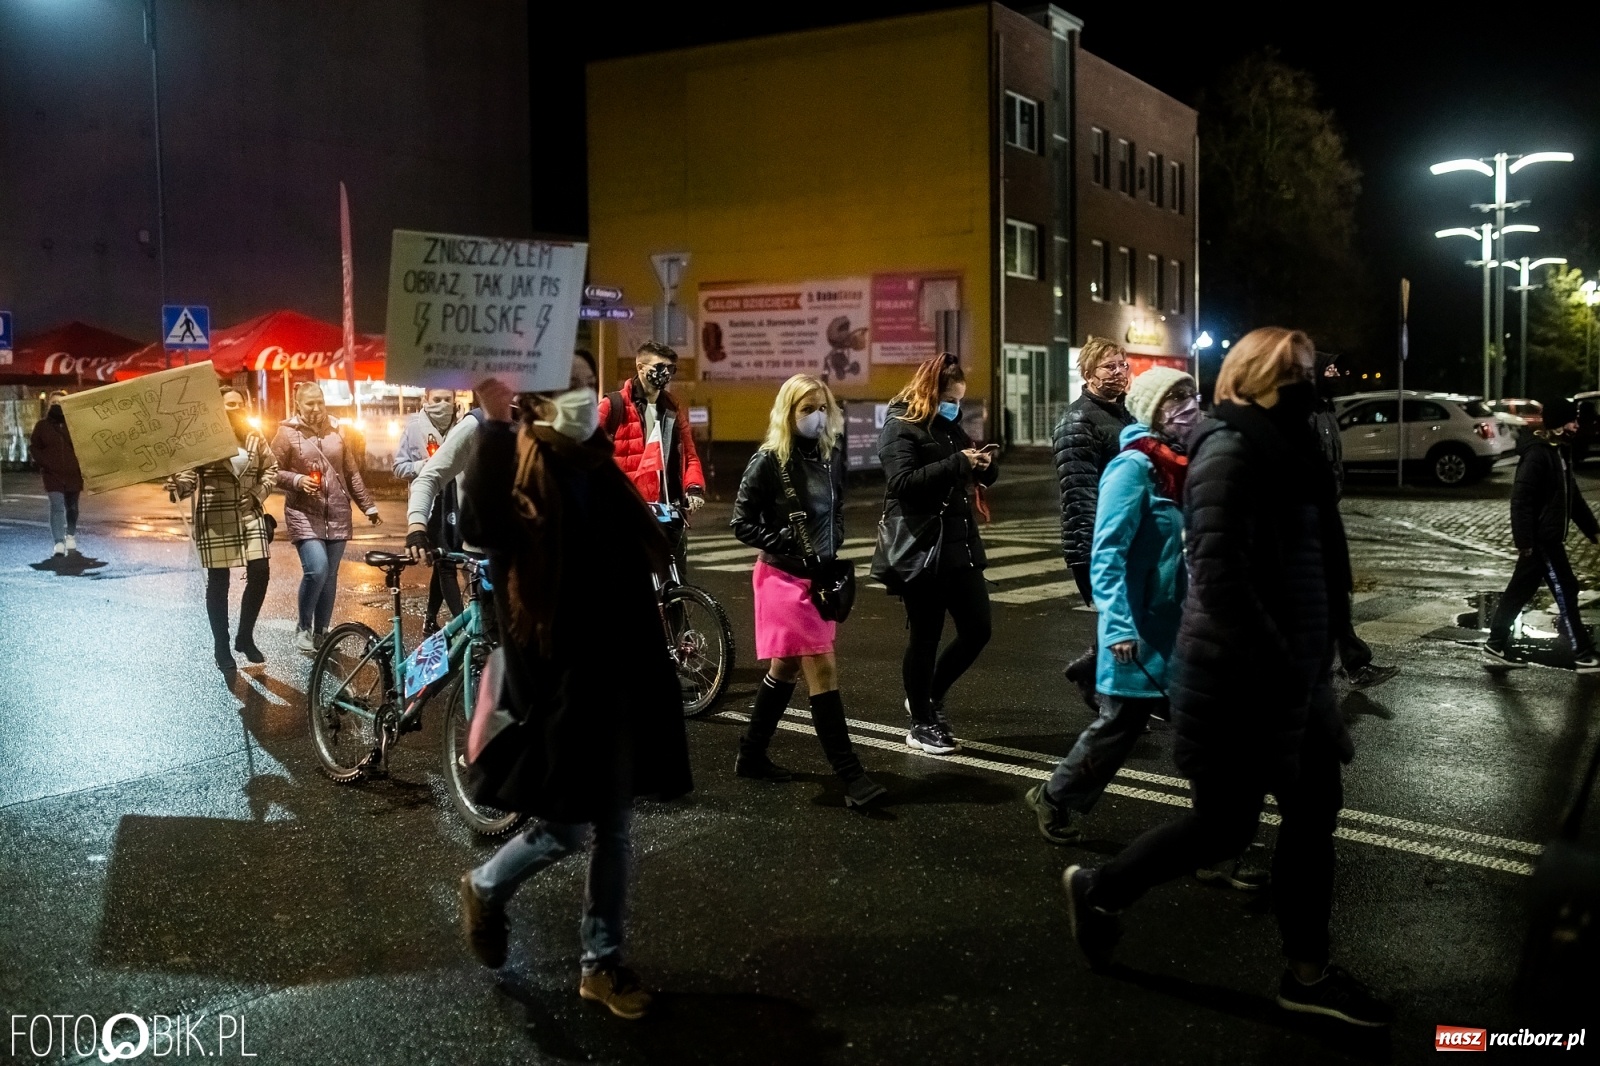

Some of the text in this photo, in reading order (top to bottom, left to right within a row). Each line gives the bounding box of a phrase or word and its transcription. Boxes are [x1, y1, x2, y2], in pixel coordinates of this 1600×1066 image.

[423, 236, 553, 269] ZNISZCZYŁEM
[403, 270, 561, 300] OBRAZ, TAK JAK PIS
[441, 303, 526, 337] POLSKĘ
